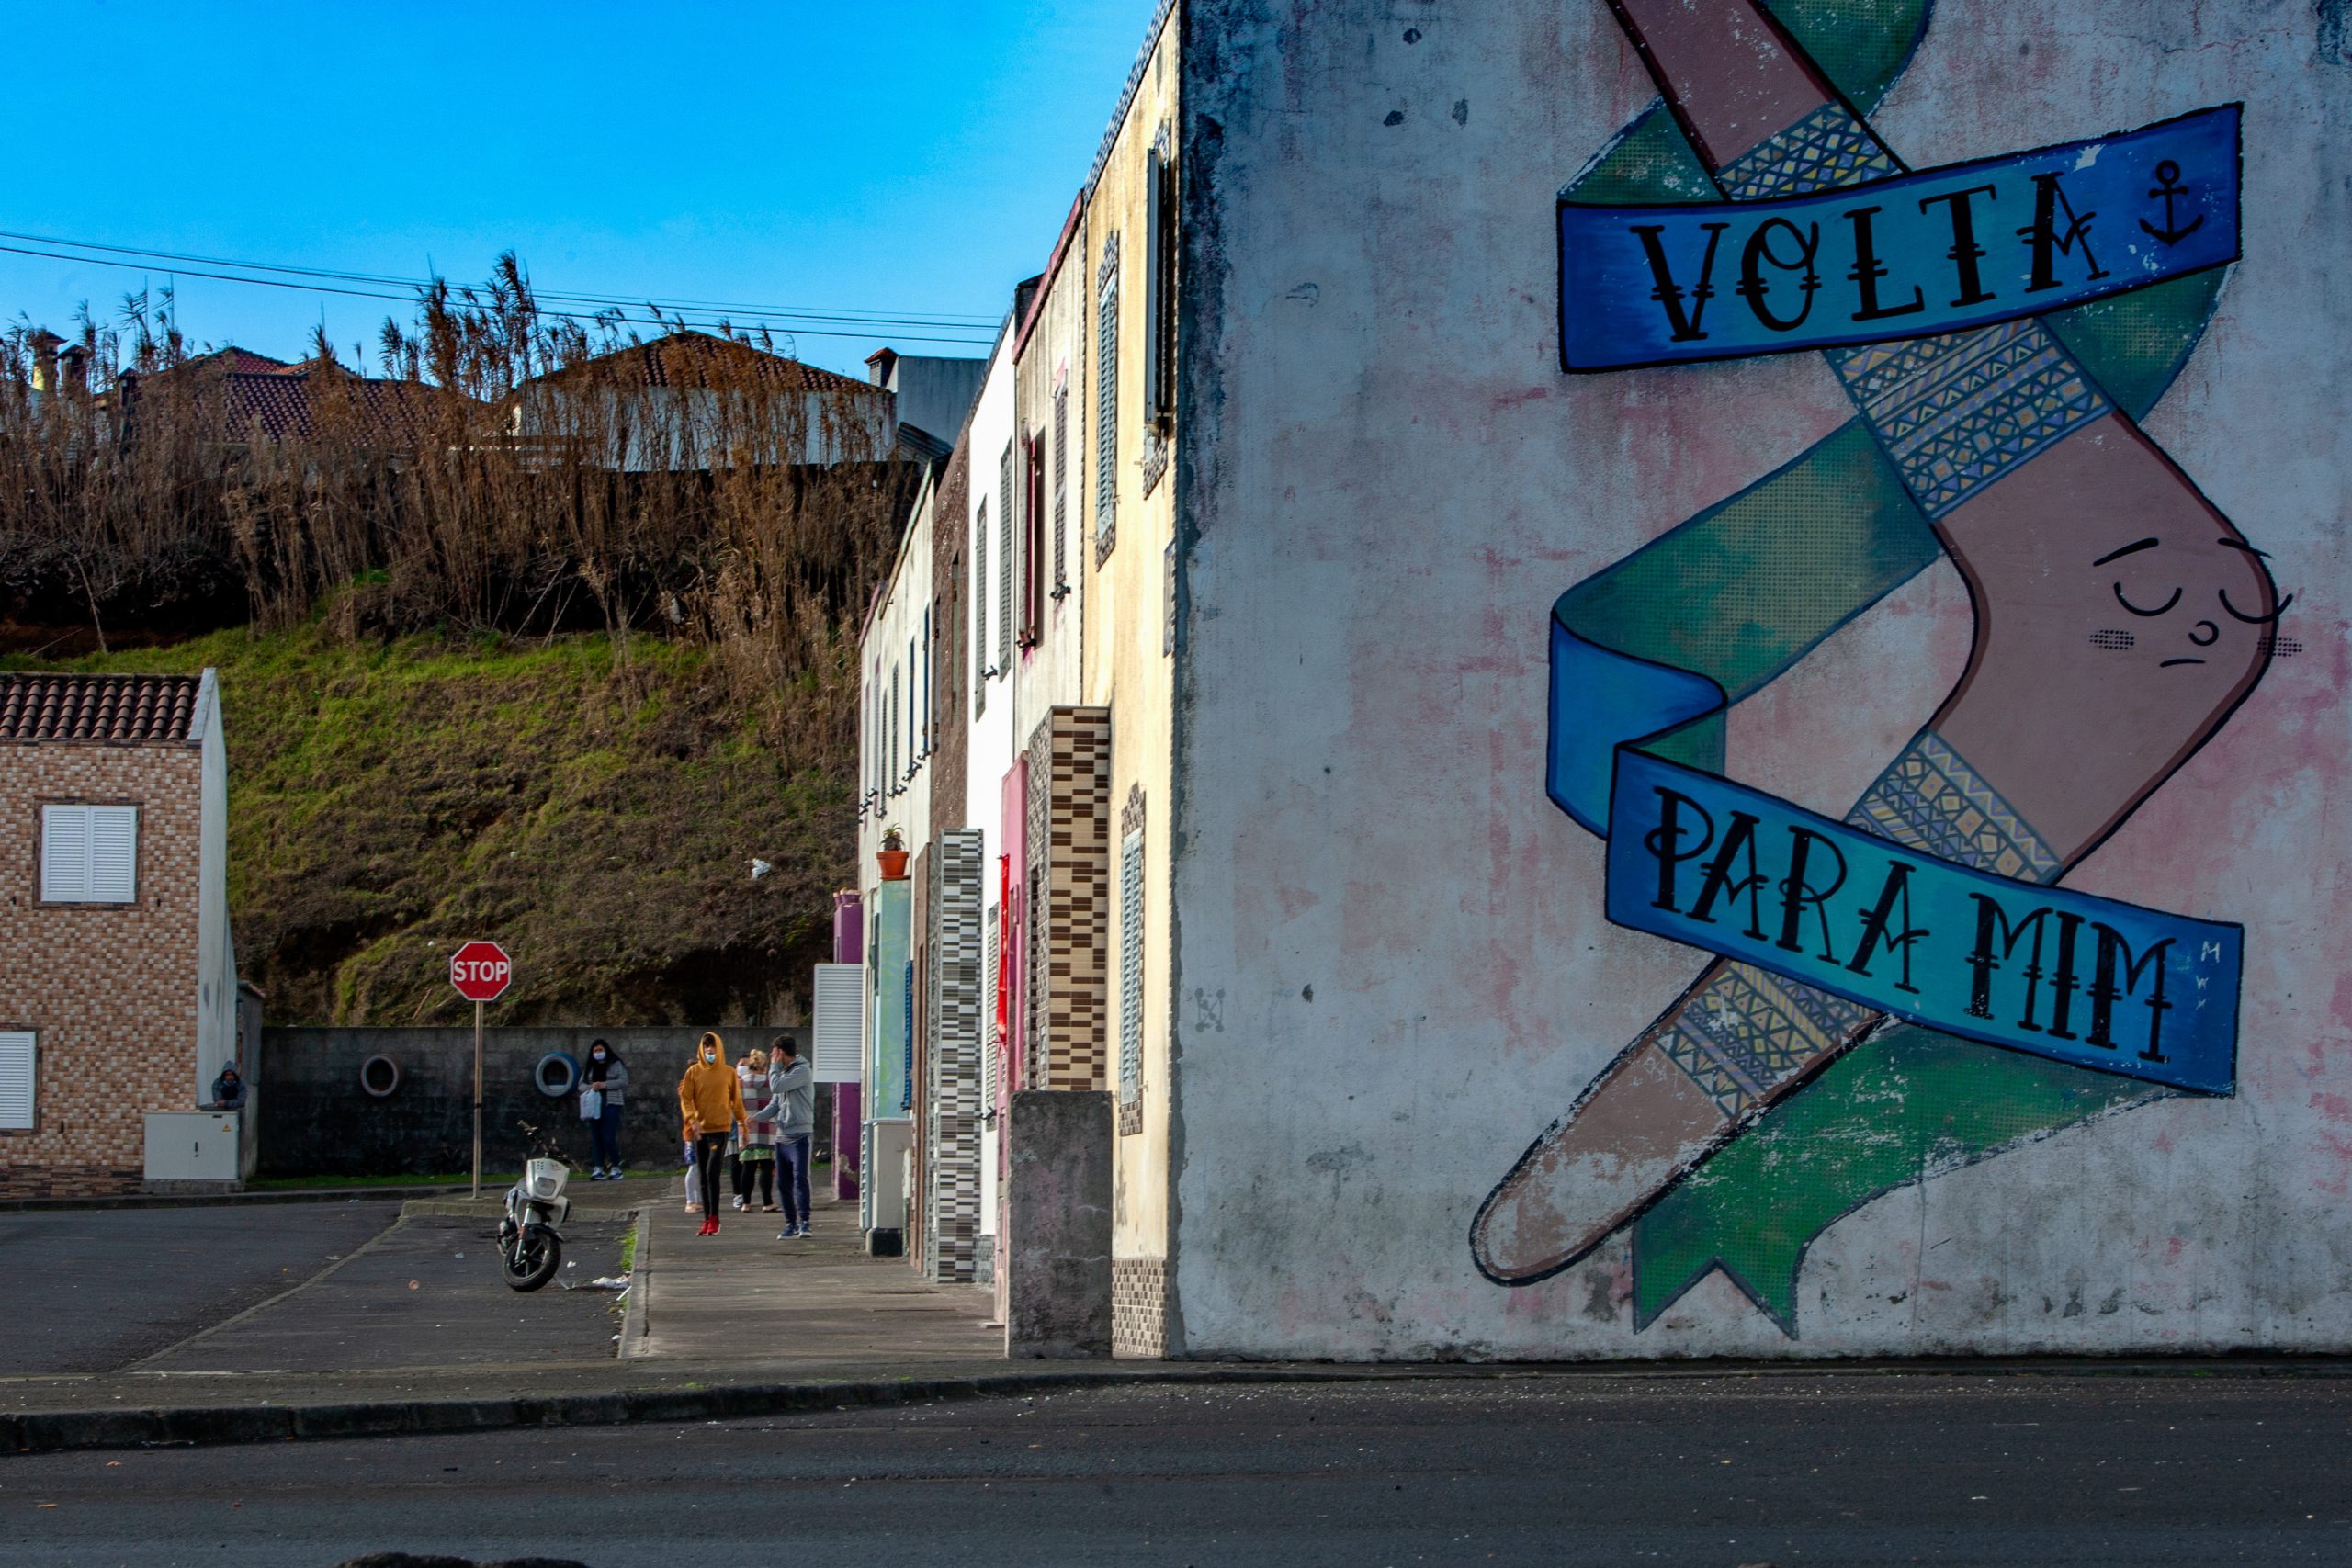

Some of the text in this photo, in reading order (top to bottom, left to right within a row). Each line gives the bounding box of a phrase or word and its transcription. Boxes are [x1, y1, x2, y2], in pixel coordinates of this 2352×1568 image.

[1630, 171, 2110, 344] VOLTA
[454, 960, 509, 982] STOP
[1644, 785, 2177, 1065] PARA MIM
